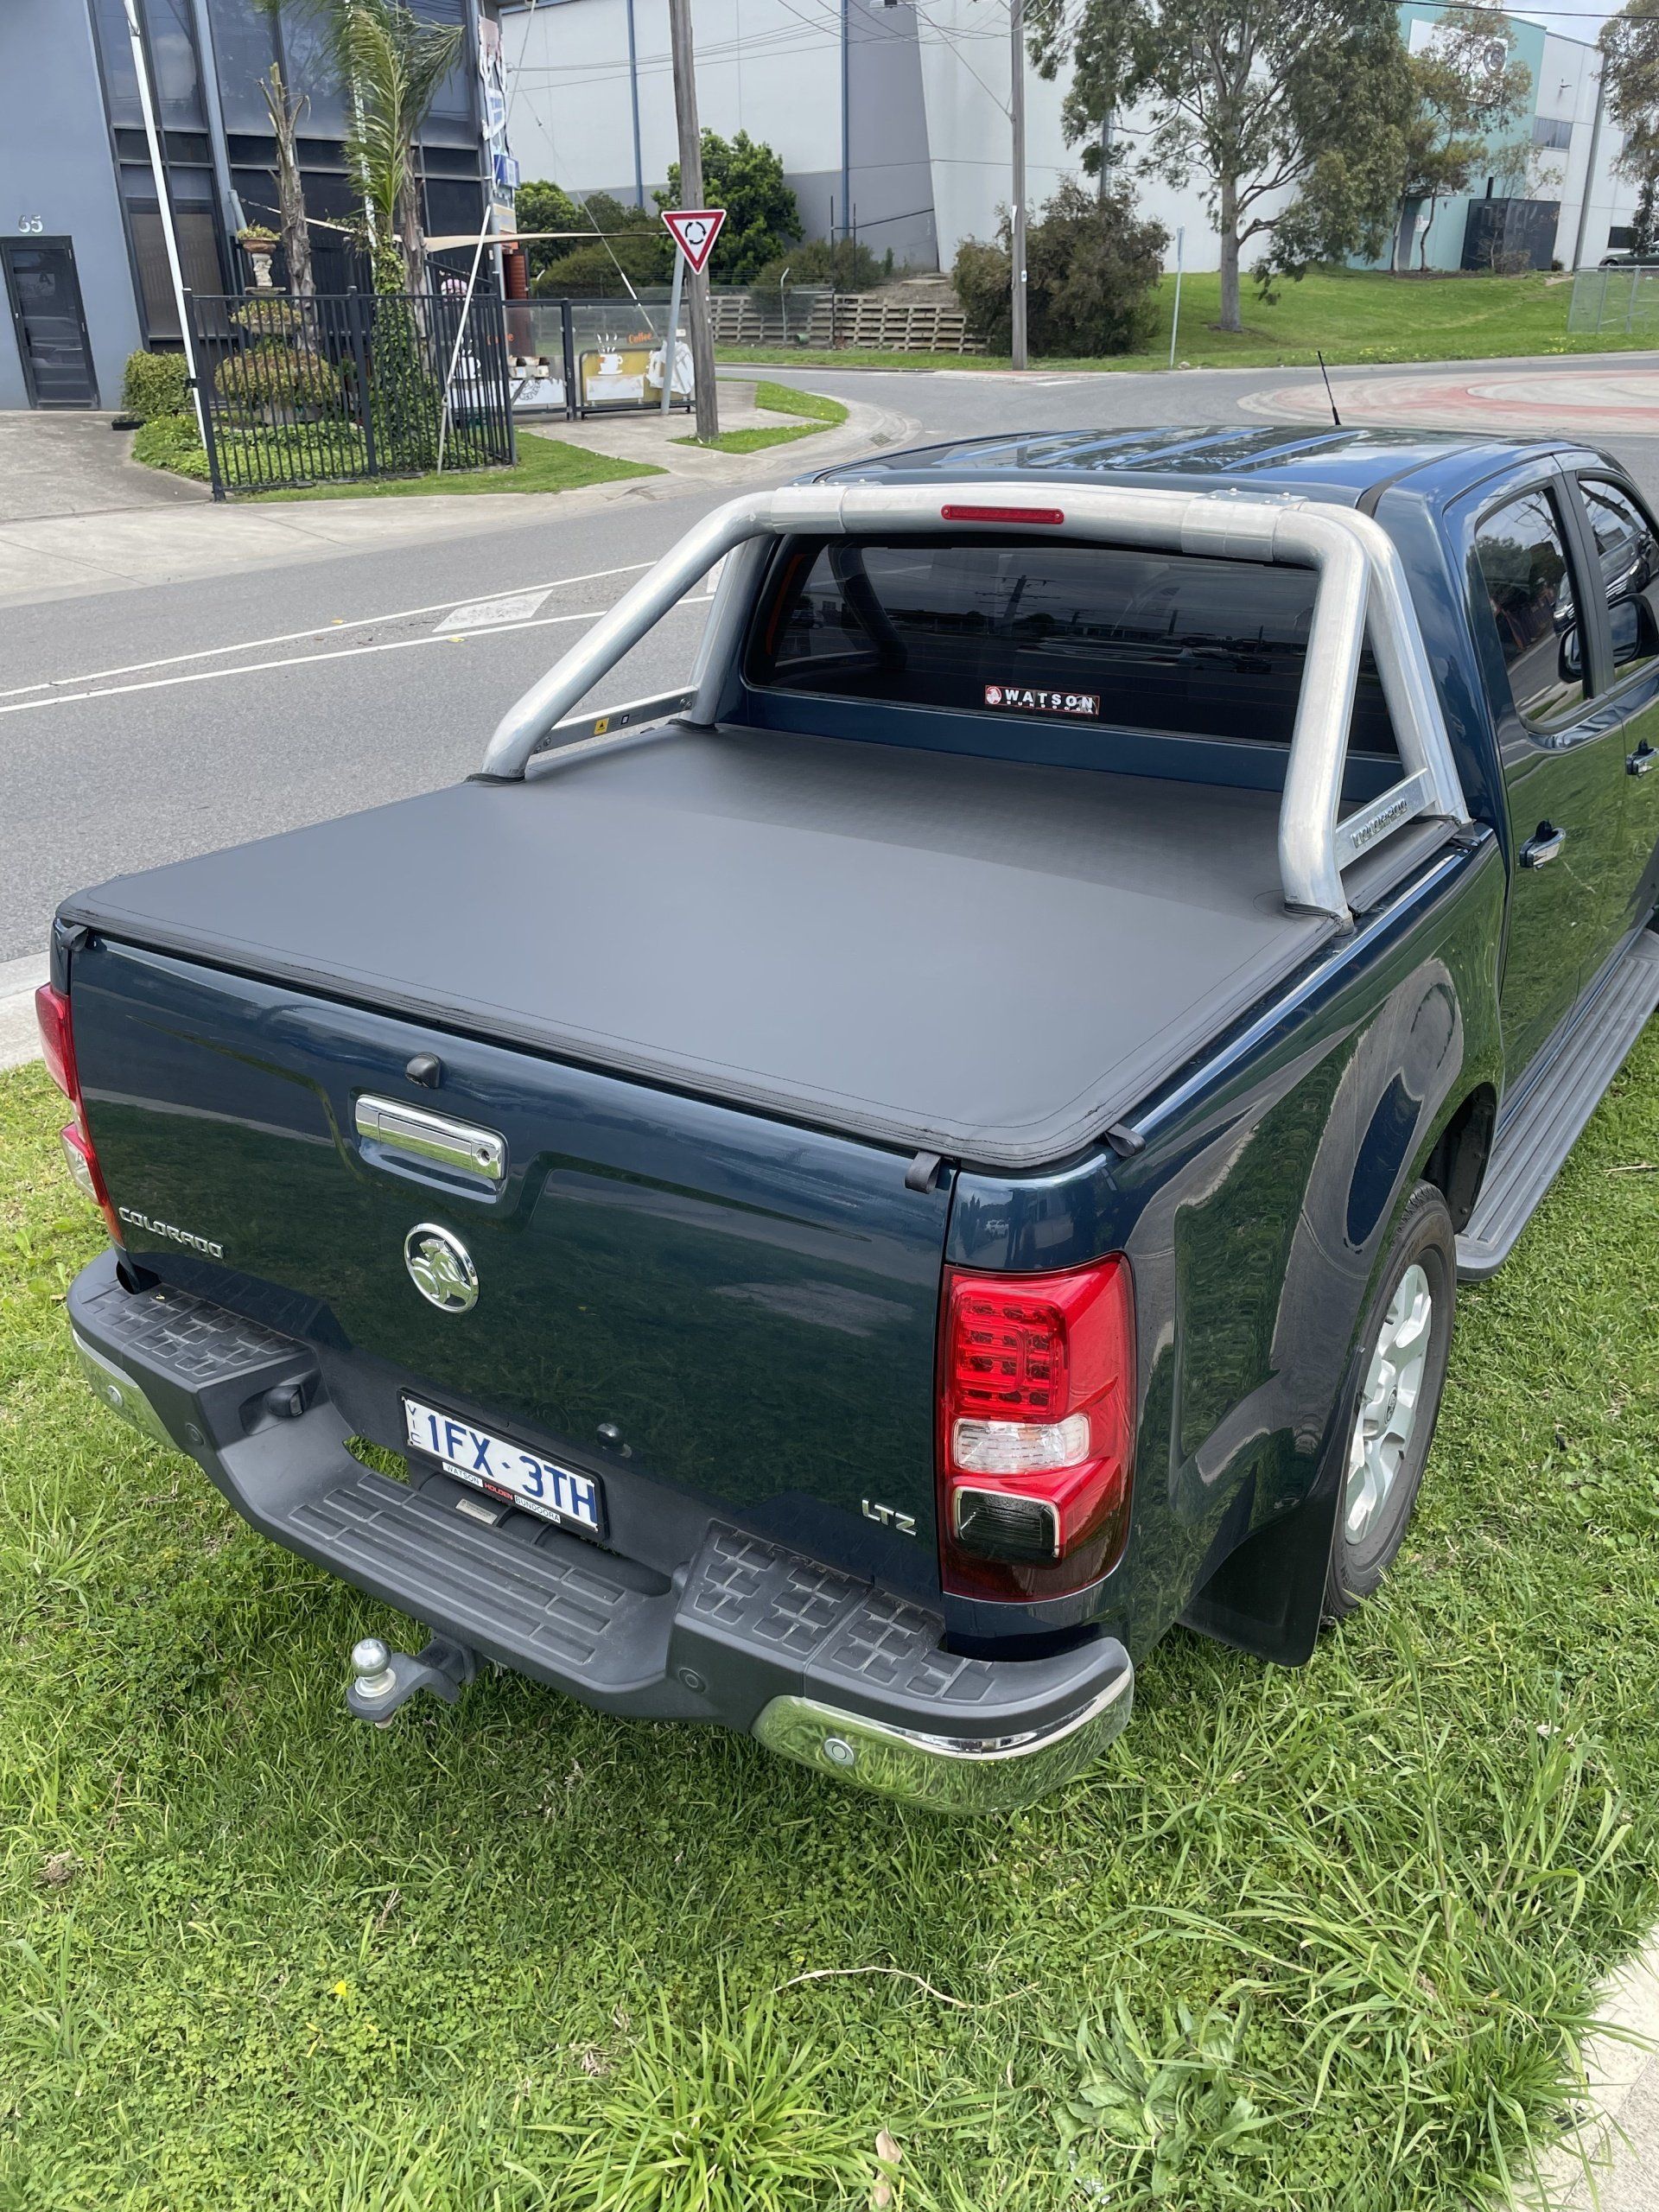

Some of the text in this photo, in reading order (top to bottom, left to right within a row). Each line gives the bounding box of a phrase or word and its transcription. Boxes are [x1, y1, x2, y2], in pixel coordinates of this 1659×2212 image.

[19, 214, 43, 233] 65
[1005, 689, 1094, 709] WATSON
[118, 1206, 224, 1260] COLORADO
[407, 1403, 422, 1445] VIC
[446, 1465, 480, 1486] WATSON
[484, 1483, 514, 1501] HOLDEN
[515, 1495, 561, 1522] BUNDOORA
[861, 1499, 917, 1536] LTZ
